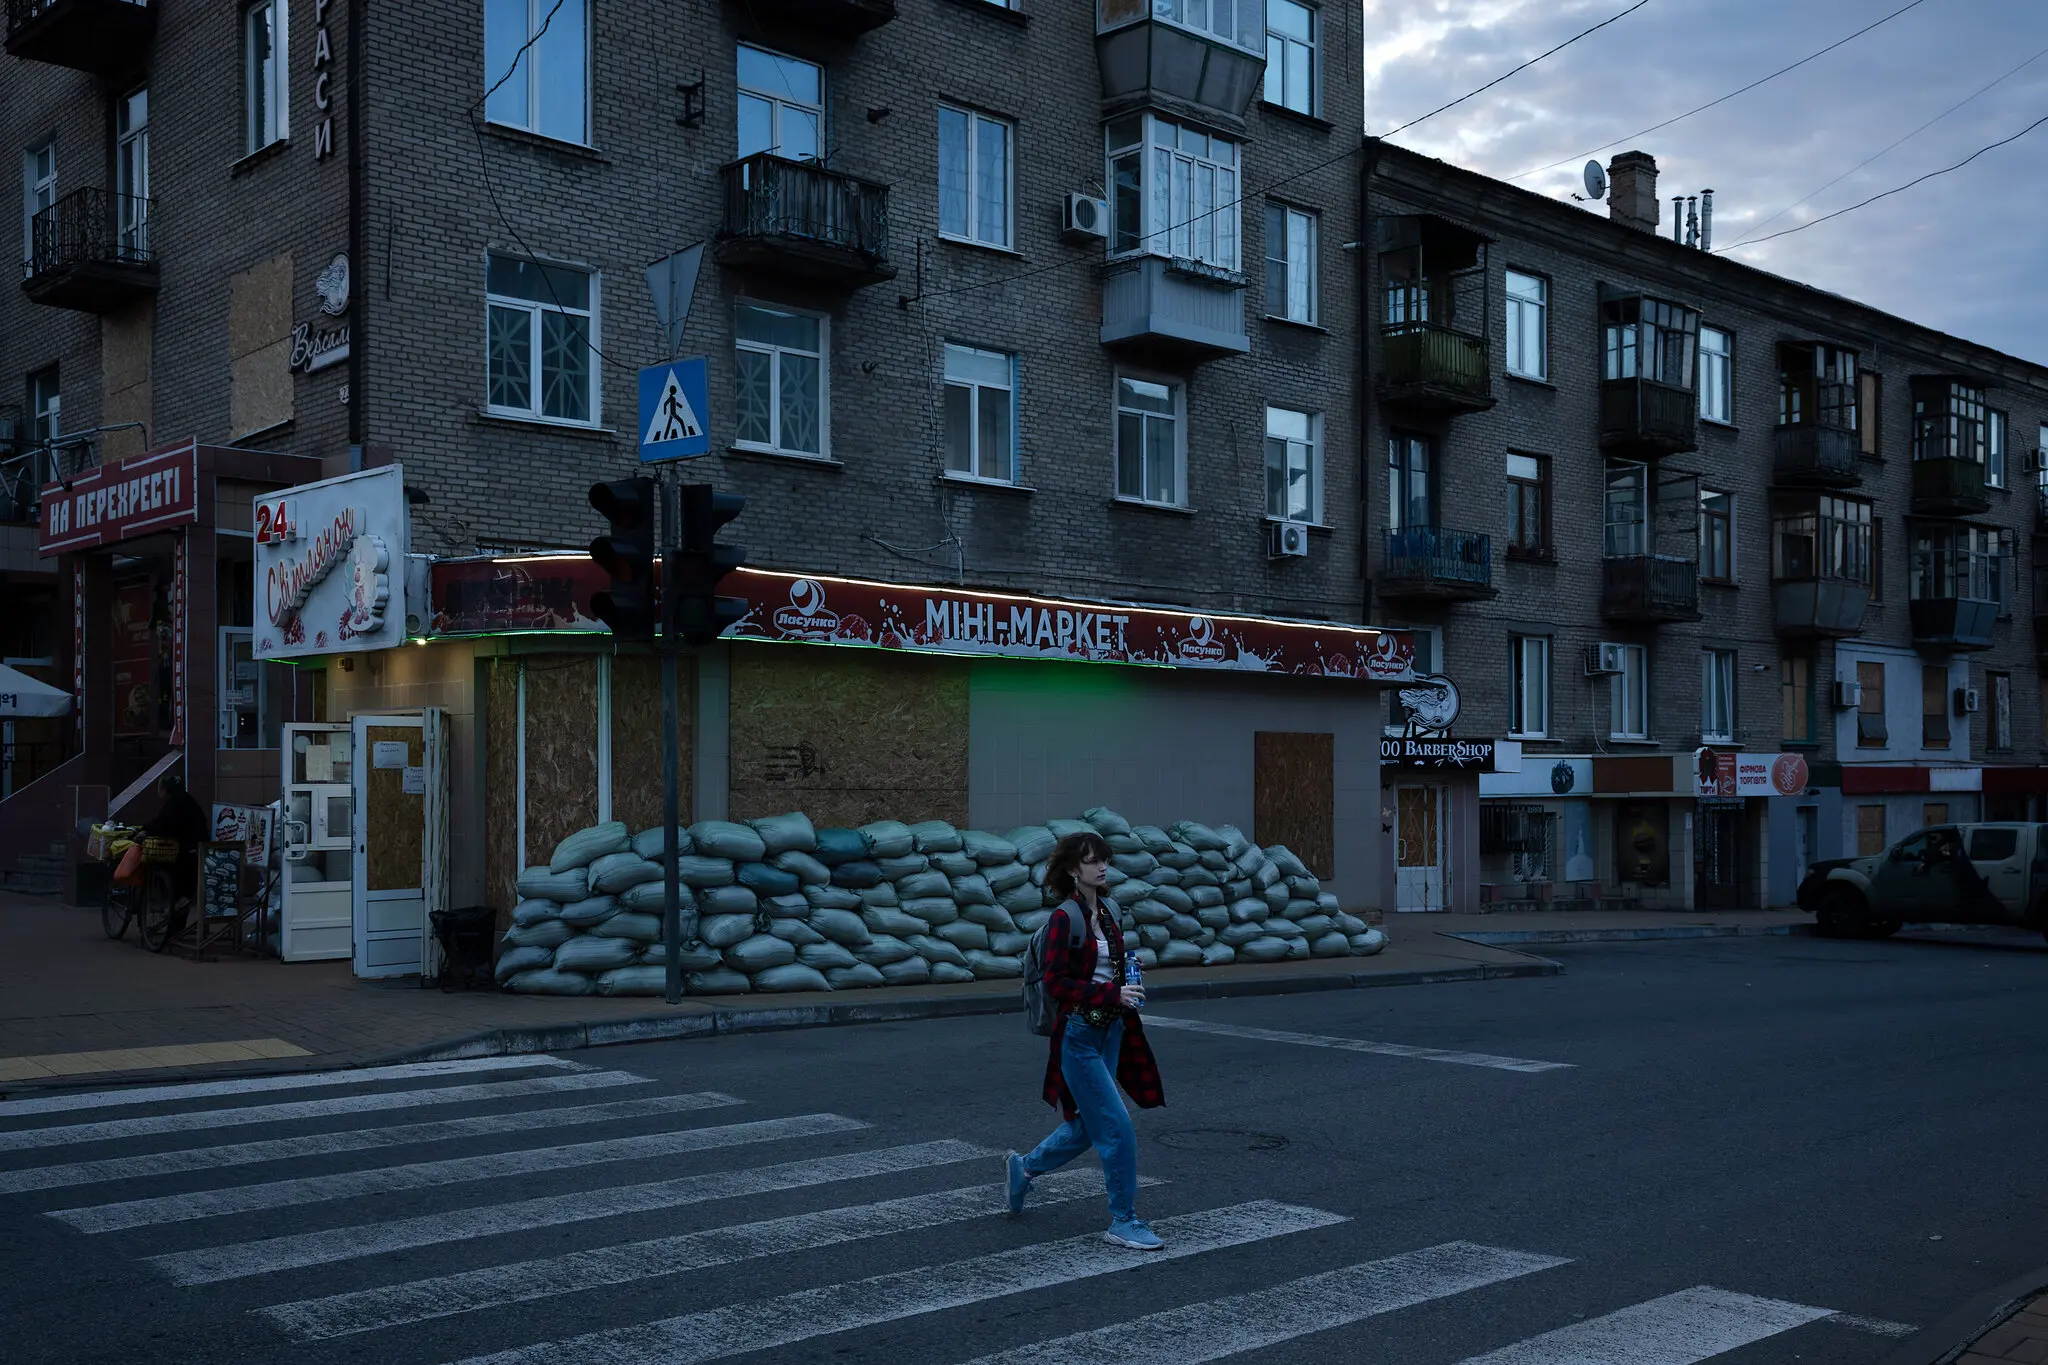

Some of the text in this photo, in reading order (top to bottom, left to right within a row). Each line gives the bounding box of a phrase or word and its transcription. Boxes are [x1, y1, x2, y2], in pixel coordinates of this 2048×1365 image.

[49, 466, 181, 536] НА ПЕРЕХРЕСТІ
[268, 507, 354, 626] Світлячок
[778, 613, 836, 628] Ласунка
[925, 598, 1129, 652] МІНІ-МАРКЕТ
[1182, 644, 1223, 656] Ласунка
[1370, 659, 1404, 670] Ласунка
[1739, 765, 1767, 773] ФІРМОВА
[1739, 776, 1767, 785] ТОРГІВЛЯ
